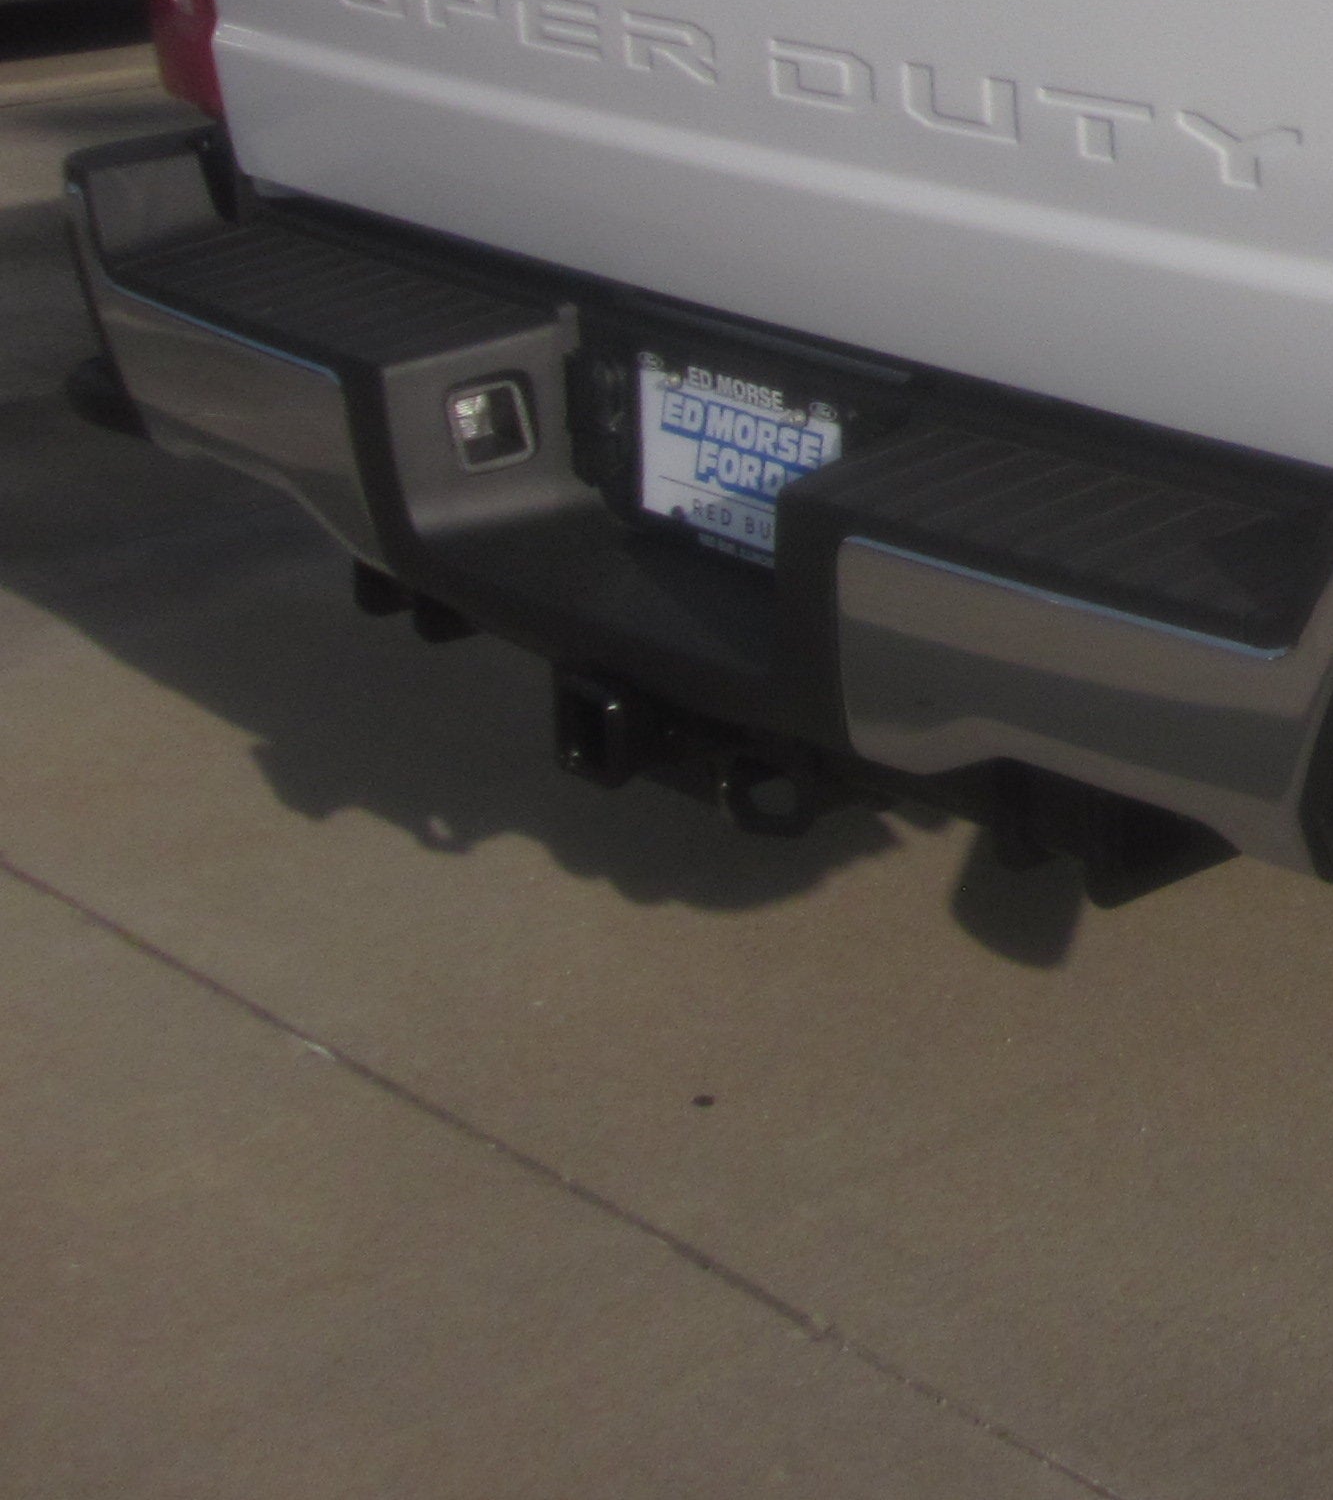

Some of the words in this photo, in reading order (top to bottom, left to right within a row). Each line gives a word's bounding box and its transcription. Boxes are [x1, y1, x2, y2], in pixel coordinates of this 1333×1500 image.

[768, 37, 1305, 191] DUTY
[686, 365, 713, 391] ED
[716, 373, 785, 413] MORSE
[662, 389, 704, 433] ED
[704, 402, 825, 471] MORSE
[696, 439, 787, 497] FORD
[692, 497, 733, 527] RED
[744, 514, 775, 542] BU
